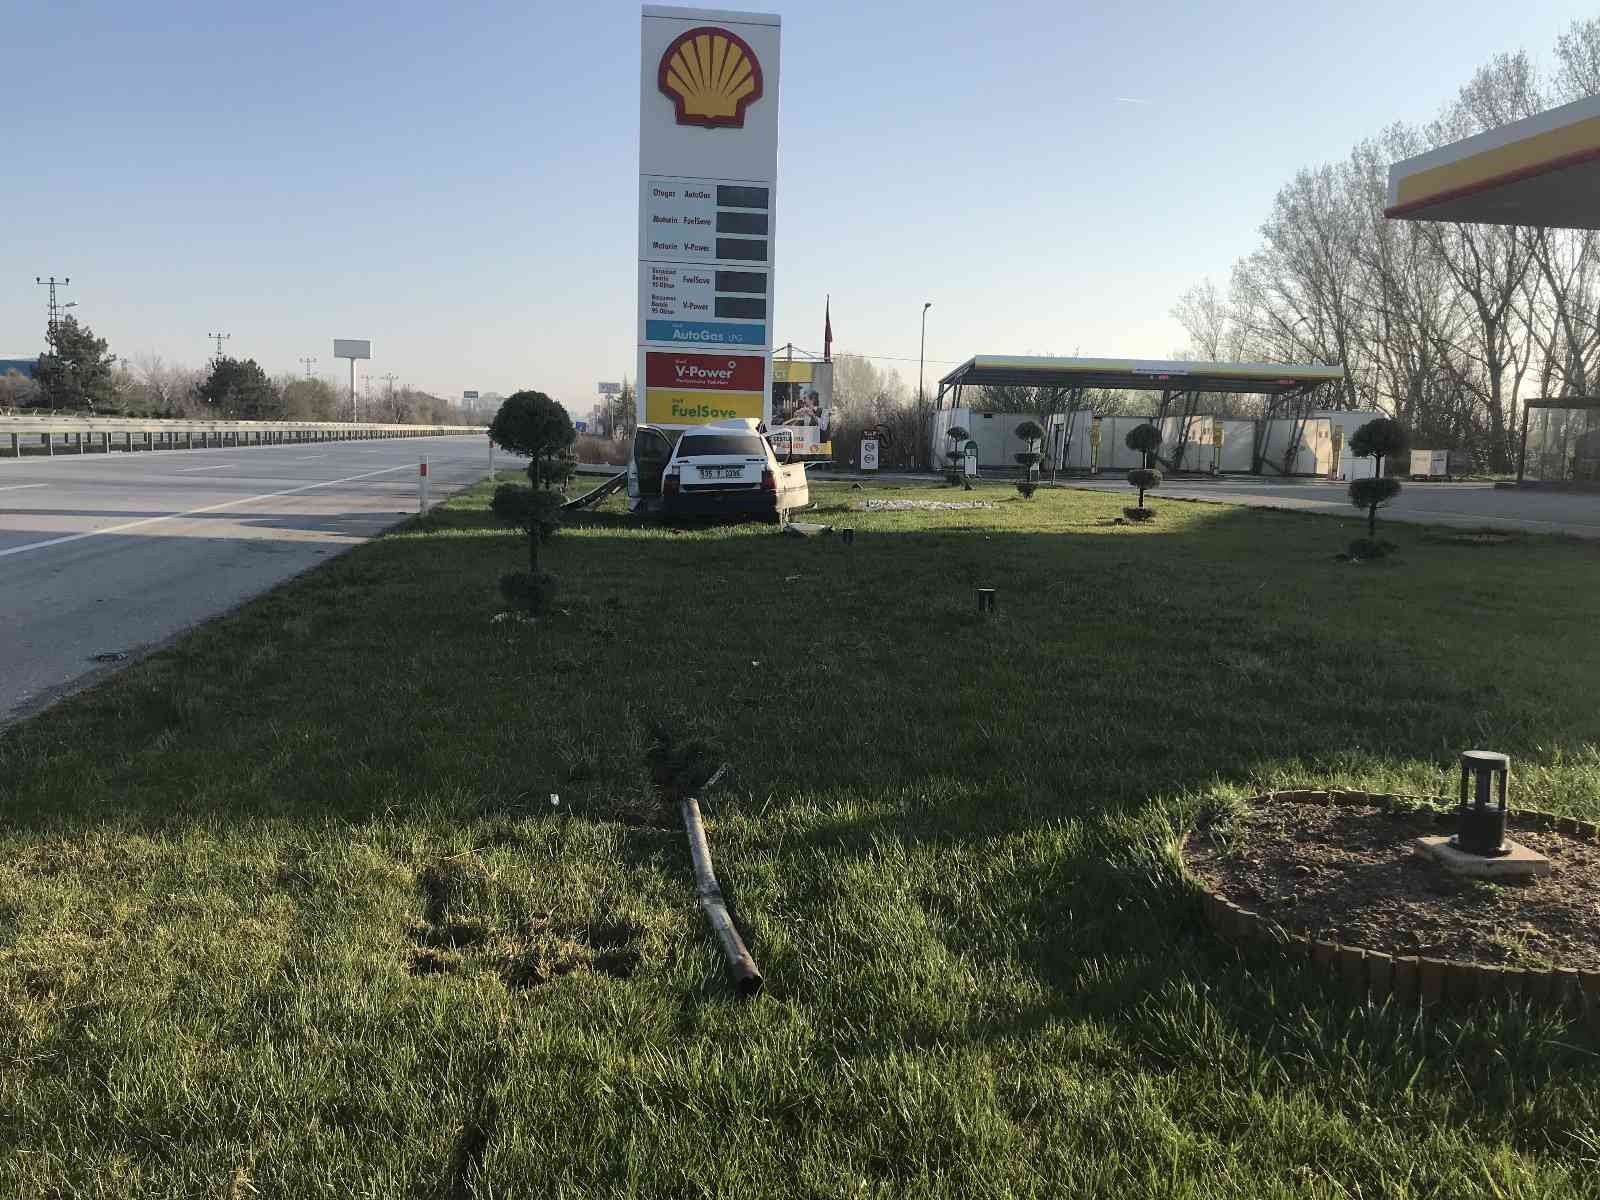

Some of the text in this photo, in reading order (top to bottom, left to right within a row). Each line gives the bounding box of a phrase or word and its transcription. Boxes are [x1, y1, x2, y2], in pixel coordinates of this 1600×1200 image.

[683, 216, 711, 225] FuelSave
[682, 275, 711, 285] FuelSave
[682, 299, 708, 311] V-Power
[672, 328, 724, 342] AutoGas
[675, 364, 734, 379] V-Power
[672, 404, 737, 418] FuelSave
